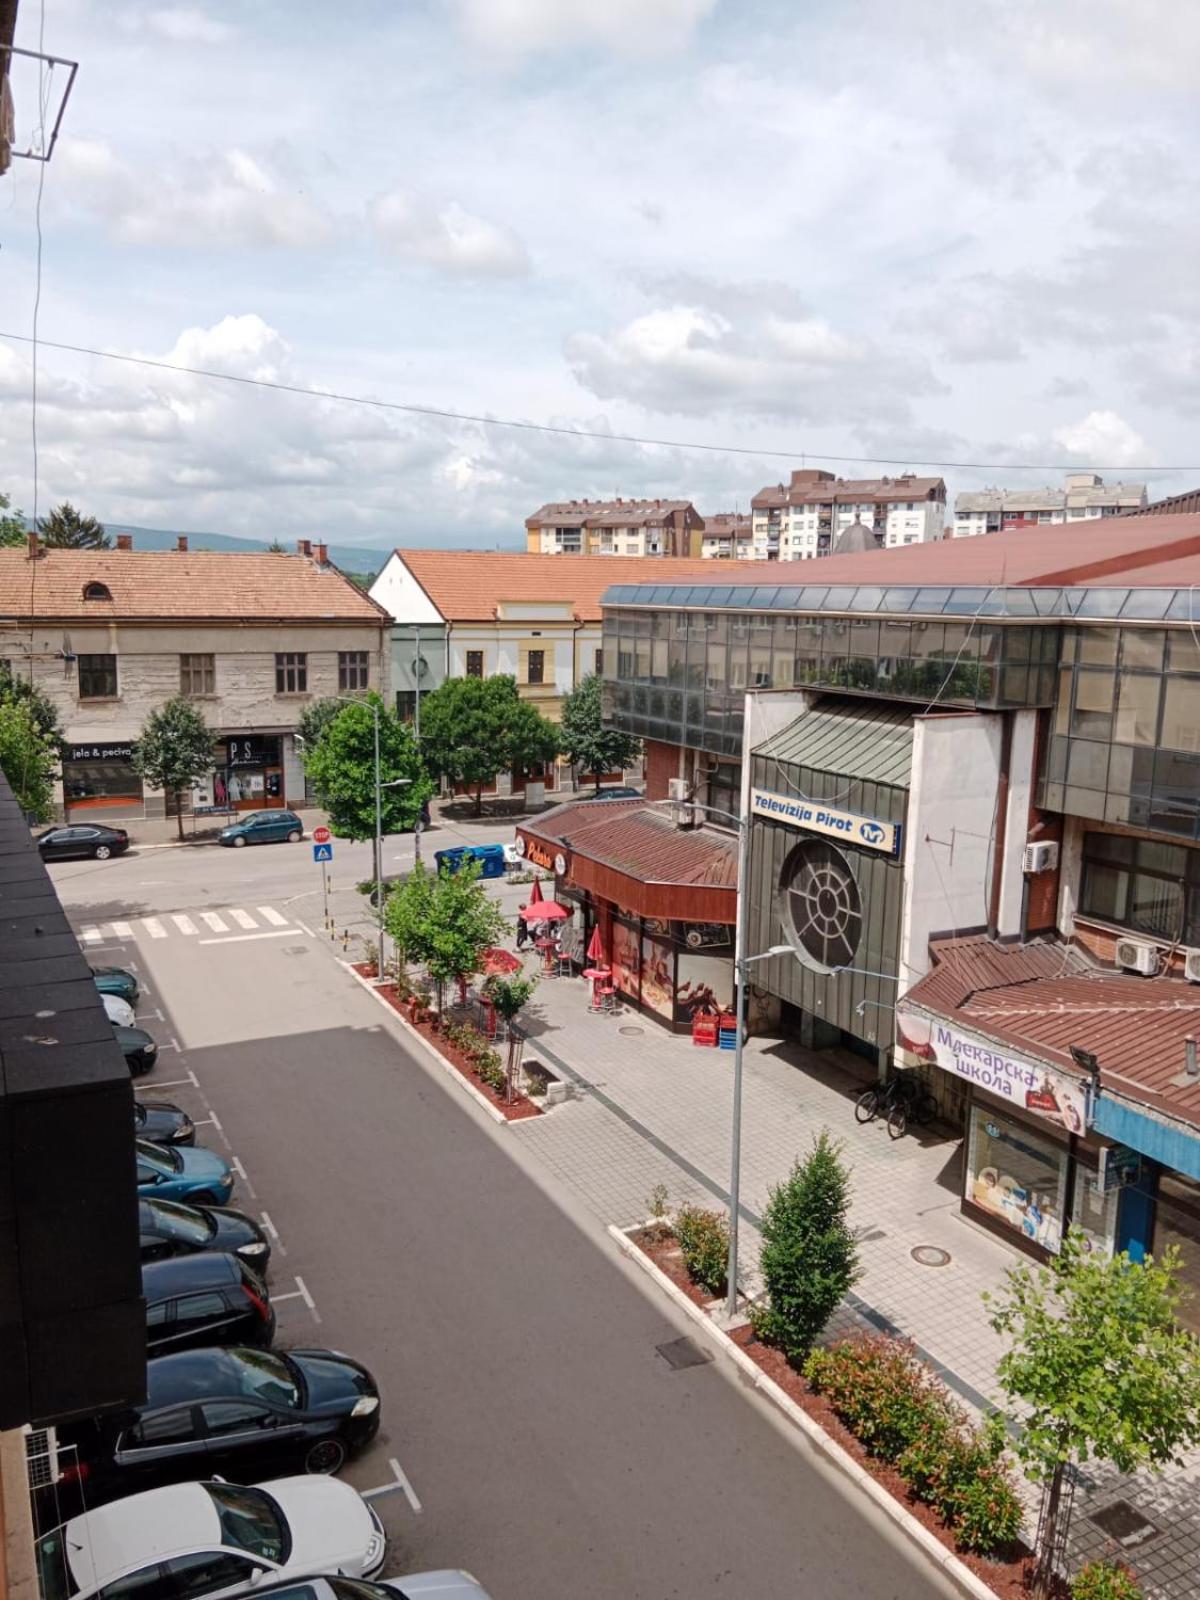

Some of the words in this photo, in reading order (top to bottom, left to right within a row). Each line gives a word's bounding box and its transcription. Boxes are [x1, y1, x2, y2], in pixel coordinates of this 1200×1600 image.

[92, 748, 100, 757] &
[755, 795, 812, 821] Televizija
[815, 811, 853, 832] Pirot
[937, 1028, 1036, 1087] Млекарска
[956, 1059, 1013, 1096] школа
